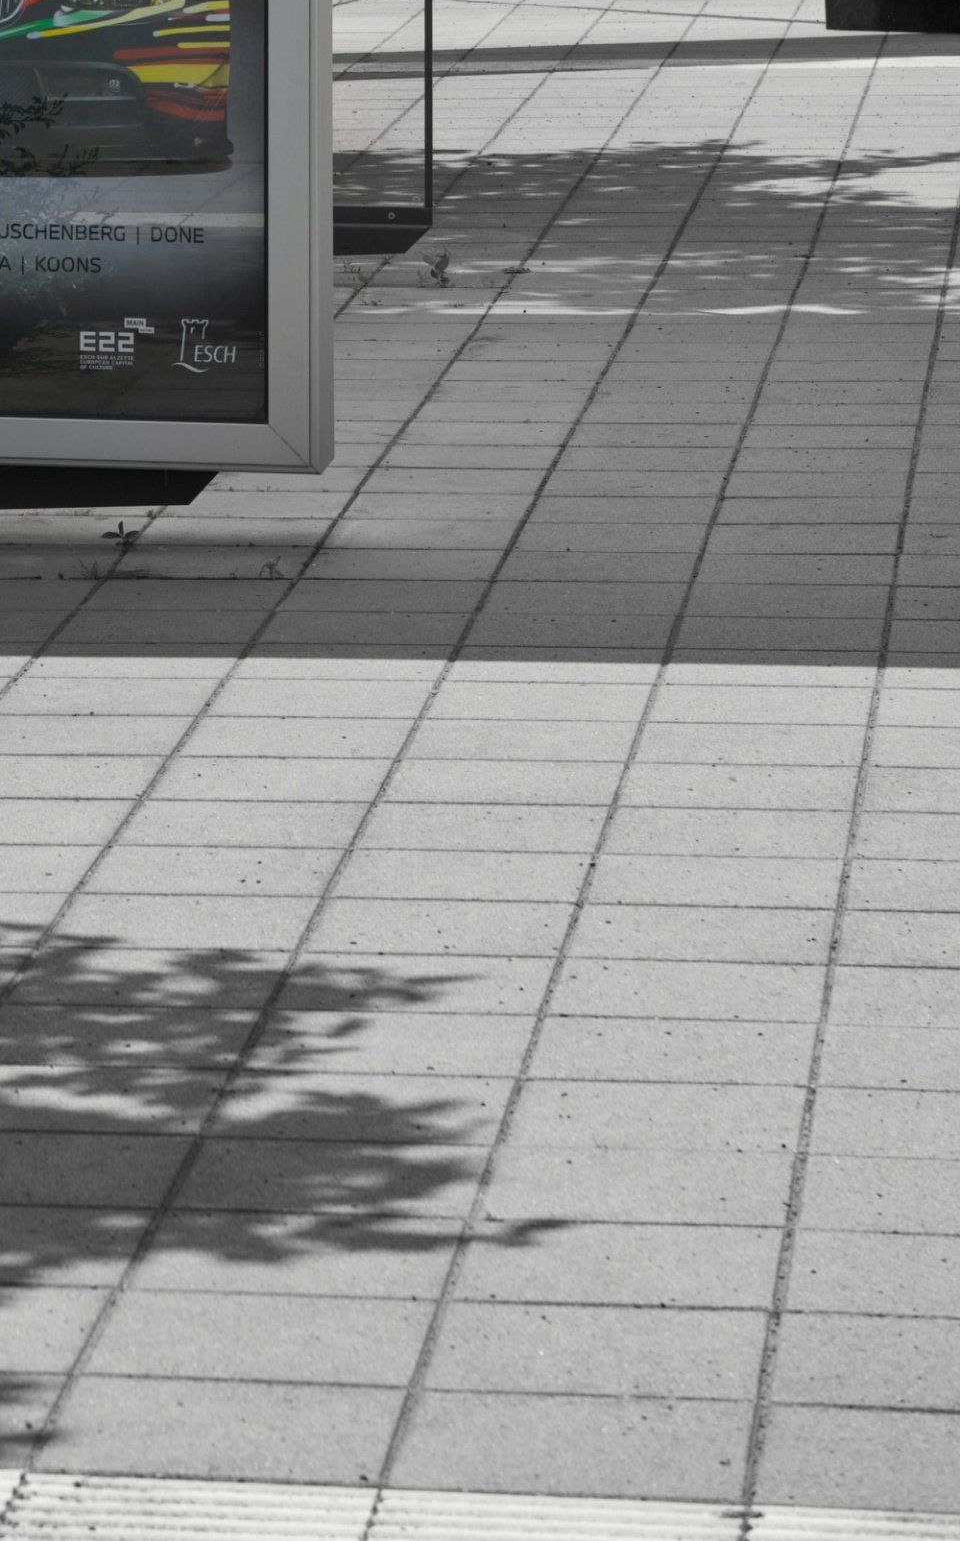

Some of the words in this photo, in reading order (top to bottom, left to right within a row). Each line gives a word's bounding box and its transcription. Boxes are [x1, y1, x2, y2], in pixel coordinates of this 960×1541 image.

[150, 226, 205, 244] DONE
[35, 255, 101, 274] KOONS
[79, 331, 135, 353] E22
[193, 344, 237, 364] ESCH
